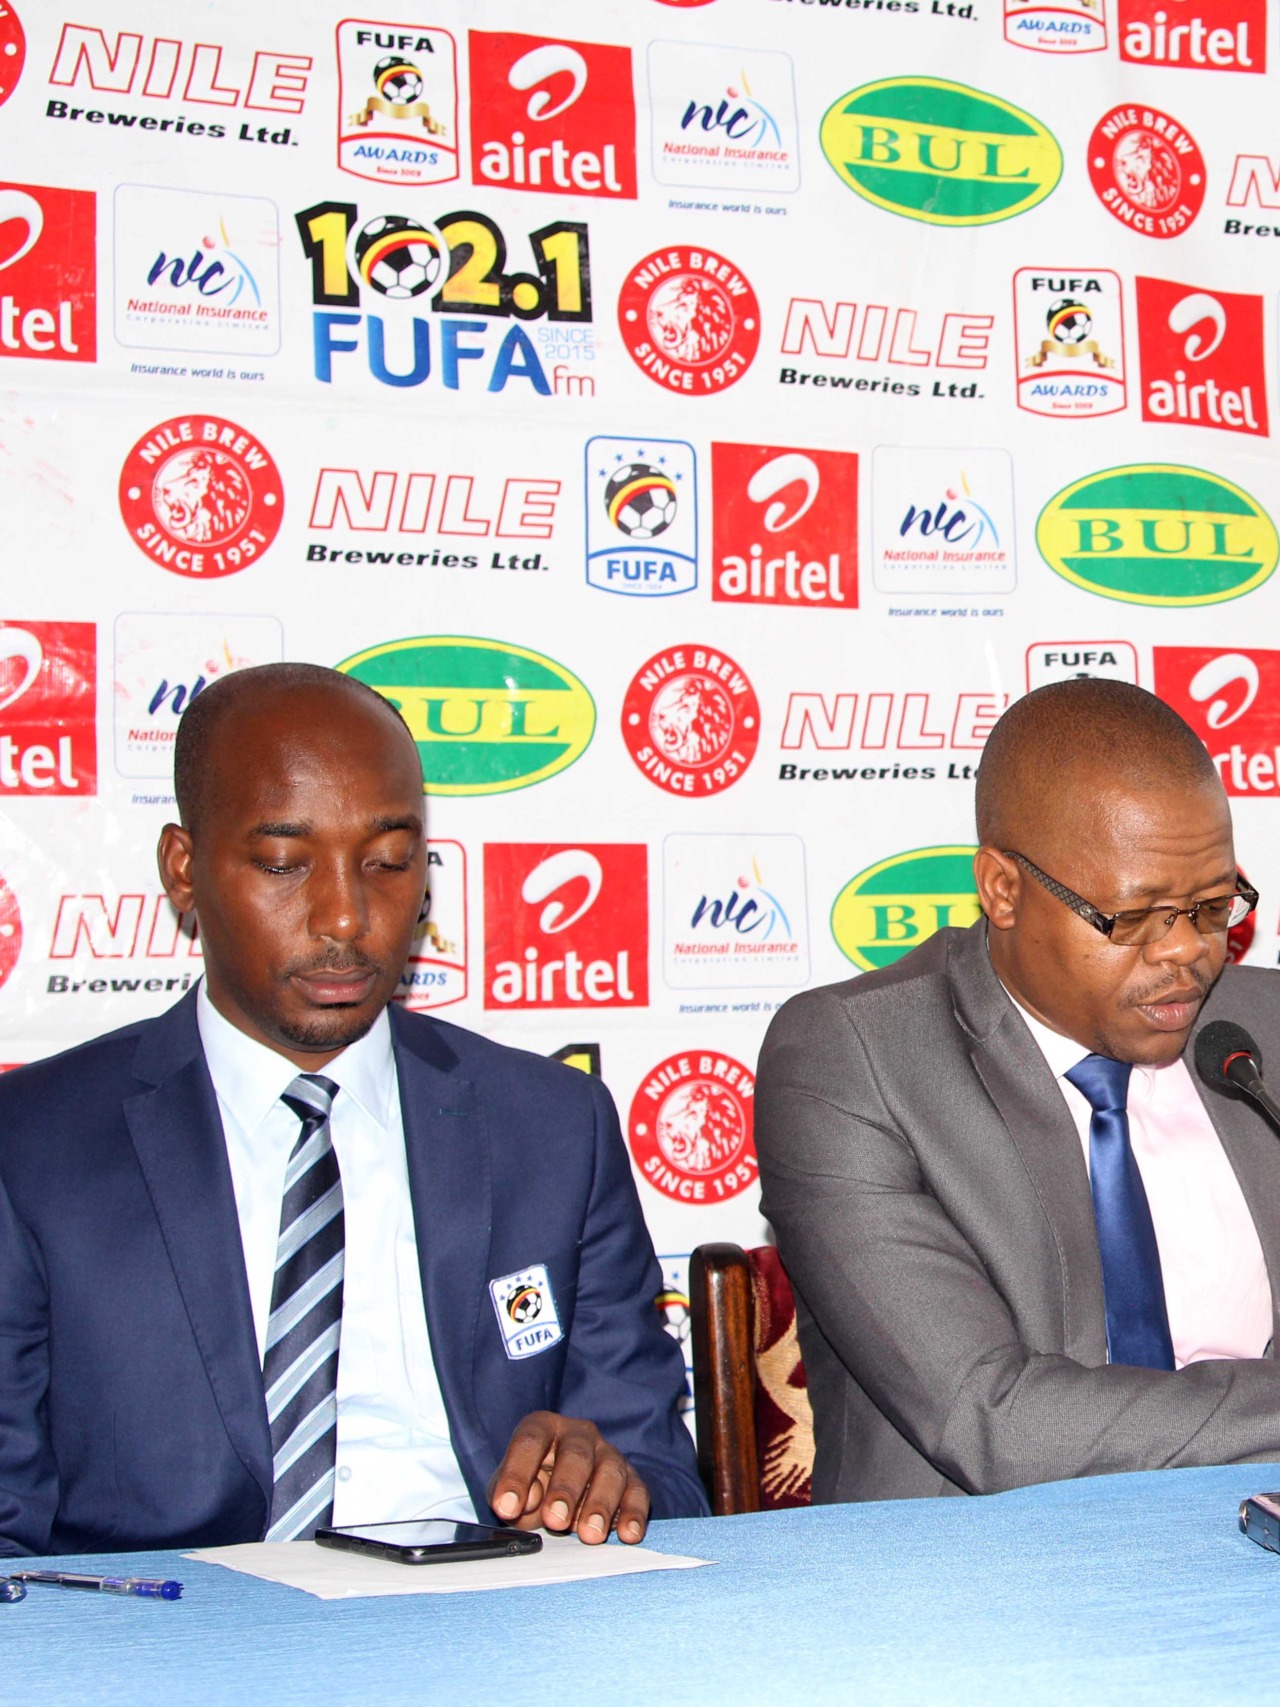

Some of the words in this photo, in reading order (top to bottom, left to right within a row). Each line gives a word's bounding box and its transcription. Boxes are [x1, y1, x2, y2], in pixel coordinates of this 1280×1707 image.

[356, 31, 435, 54] FUFA
[1017, 18, 1092, 35] AWARDS
[1124, 17, 1252, 67] airtel
[49, 23, 312, 114] NILE
[46, 99, 226, 138] Breweries
[239, 124, 299, 147] Ltd.
[681, 86, 759, 139] nic
[1102, 110, 1137, 140] NILE
[1142, 109, 1194, 155] BREW
[353, 144, 439, 166] AWARDS
[480, 133, 622, 192] airtel
[663, 142, 720, 158] National
[724, 146, 788, 162] Insurance
[855, 124, 1031, 179] BUL
[668, 200, 718, 212] Insurance
[722, 204, 751, 214] world
[765, 206, 788, 216] ours
[1102, 185, 1155, 232] SINCE
[1159, 204, 1194, 234] 1951
[147, 236, 236, 296] nic
[634, 252, 681, 291] NILE
[689, 252, 748, 297] BREW
[1031, 277, 1102, 293] FUFA
[126, 298, 191, 316] National
[196, 304, 268, 322] Insurance
[313, 311, 553, 395] FUFA
[537, 327, 594, 344] SINCE
[544, 343, 595, 361] 2015
[781, 298, 994, 369] NILE
[131, 363, 187, 377] Insurance
[191, 367, 223, 379] world
[226, 369, 236, 379] is
[239, 371, 265, 381] ours
[552, 366, 595, 397] fm
[634, 344, 694, 389] SINCE
[701, 350, 747, 389] 1951
[779, 368, 920, 397] Breweries
[932, 381, 986, 399] Ltd.
[1030, 383, 1109, 398] AWARDS
[1149, 371, 1258, 430] airtel
[139, 422, 193, 465] NILE
[203, 422, 268, 471] BREW
[308, 468, 562, 539] NILE
[899, 488, 977, 543] nic
[136, 522, 204, 572] SINCE
[213, 529, 268, 571] 1951
[306, 544, 479, 569] Breweries
[491, 551, 549, 572] Ltd.
[883, 550, 939, 562] National
[943, 551, 1006, 562] Insurance
[1072, 517, 1254, 558] BUL
[606, 559, 677, 582] FUFA
[719, 545, 844, 602] airtel
[888, 607, 938, 617] Insurance
[941, 607, 968, 617] world
[982, 607, 1004, 617] ours
[640, 653, 686, 693] NILE
[693, 653, 747, 696] BREW
[1044, 652, 1117, 667] FUFA
[781, 693, 1010, 750] NILE
[635, 746, 695, 791] SINCE
[702, 750, 746, 791] 1951
[778, 762, 936, 781] Breweries
[691, 877, 768, 933] nic
[673, 943, 730, 956] National
[734, 942, 799, 955] Insurance
[492, 947, 634, 1002] airtel
[679, 1003, 728, 1014] Insurance
[732, 1003, 760, 1012] world
[645, 1056, 692, 1100] NILE
[699, 1053, 756, 1098] BREW
[643, 1155, 704, 1199] SINCE
[713, 1154, 759, 1197] 1951
[515, 1327, 554, 1351] FUFA
